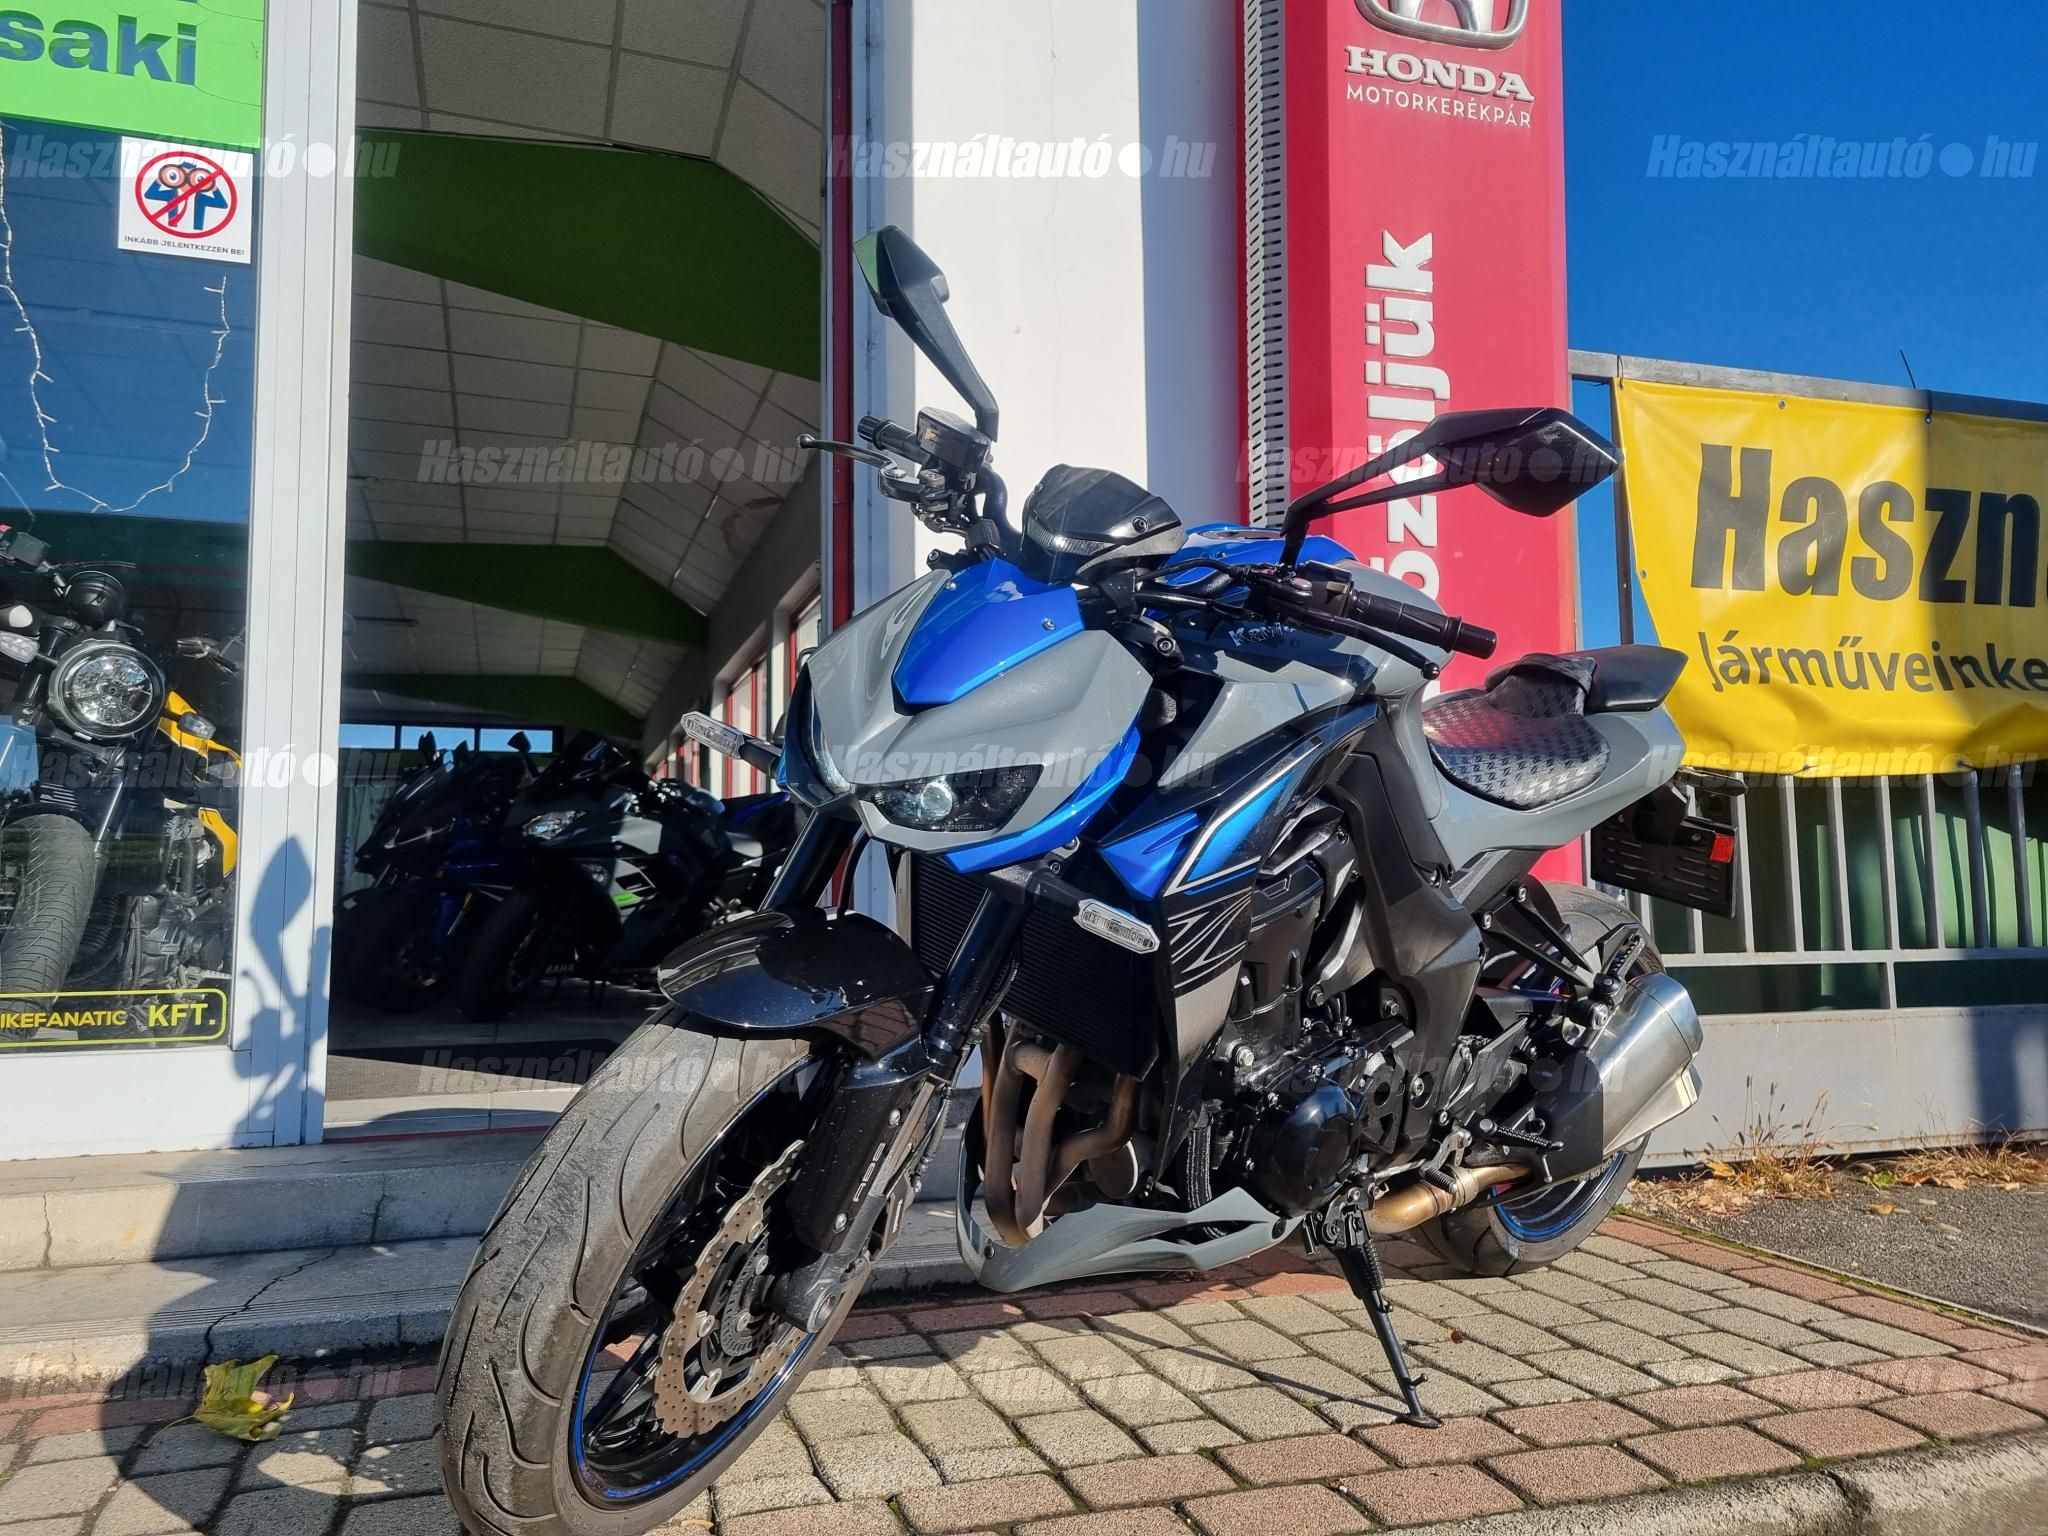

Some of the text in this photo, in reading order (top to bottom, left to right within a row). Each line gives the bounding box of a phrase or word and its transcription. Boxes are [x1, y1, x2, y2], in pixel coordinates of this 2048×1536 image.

[0, 9, 198, 86] saki
[1345, 45, 1535, 103] HONDA
[1346, 83, 1532, 128] MOTORKERÉKPÁR
[124, 235, 245, 256] INKÁBB JELENTKEZZEN BE!
[1364, 229, 1451, 614] özöljük
[1691, 443, 2048, 608] Haszn
[1698, 629, 2048, 694] Járműveinke
[0, 1002, 216, 1029] IKEFANATIC KFT.
